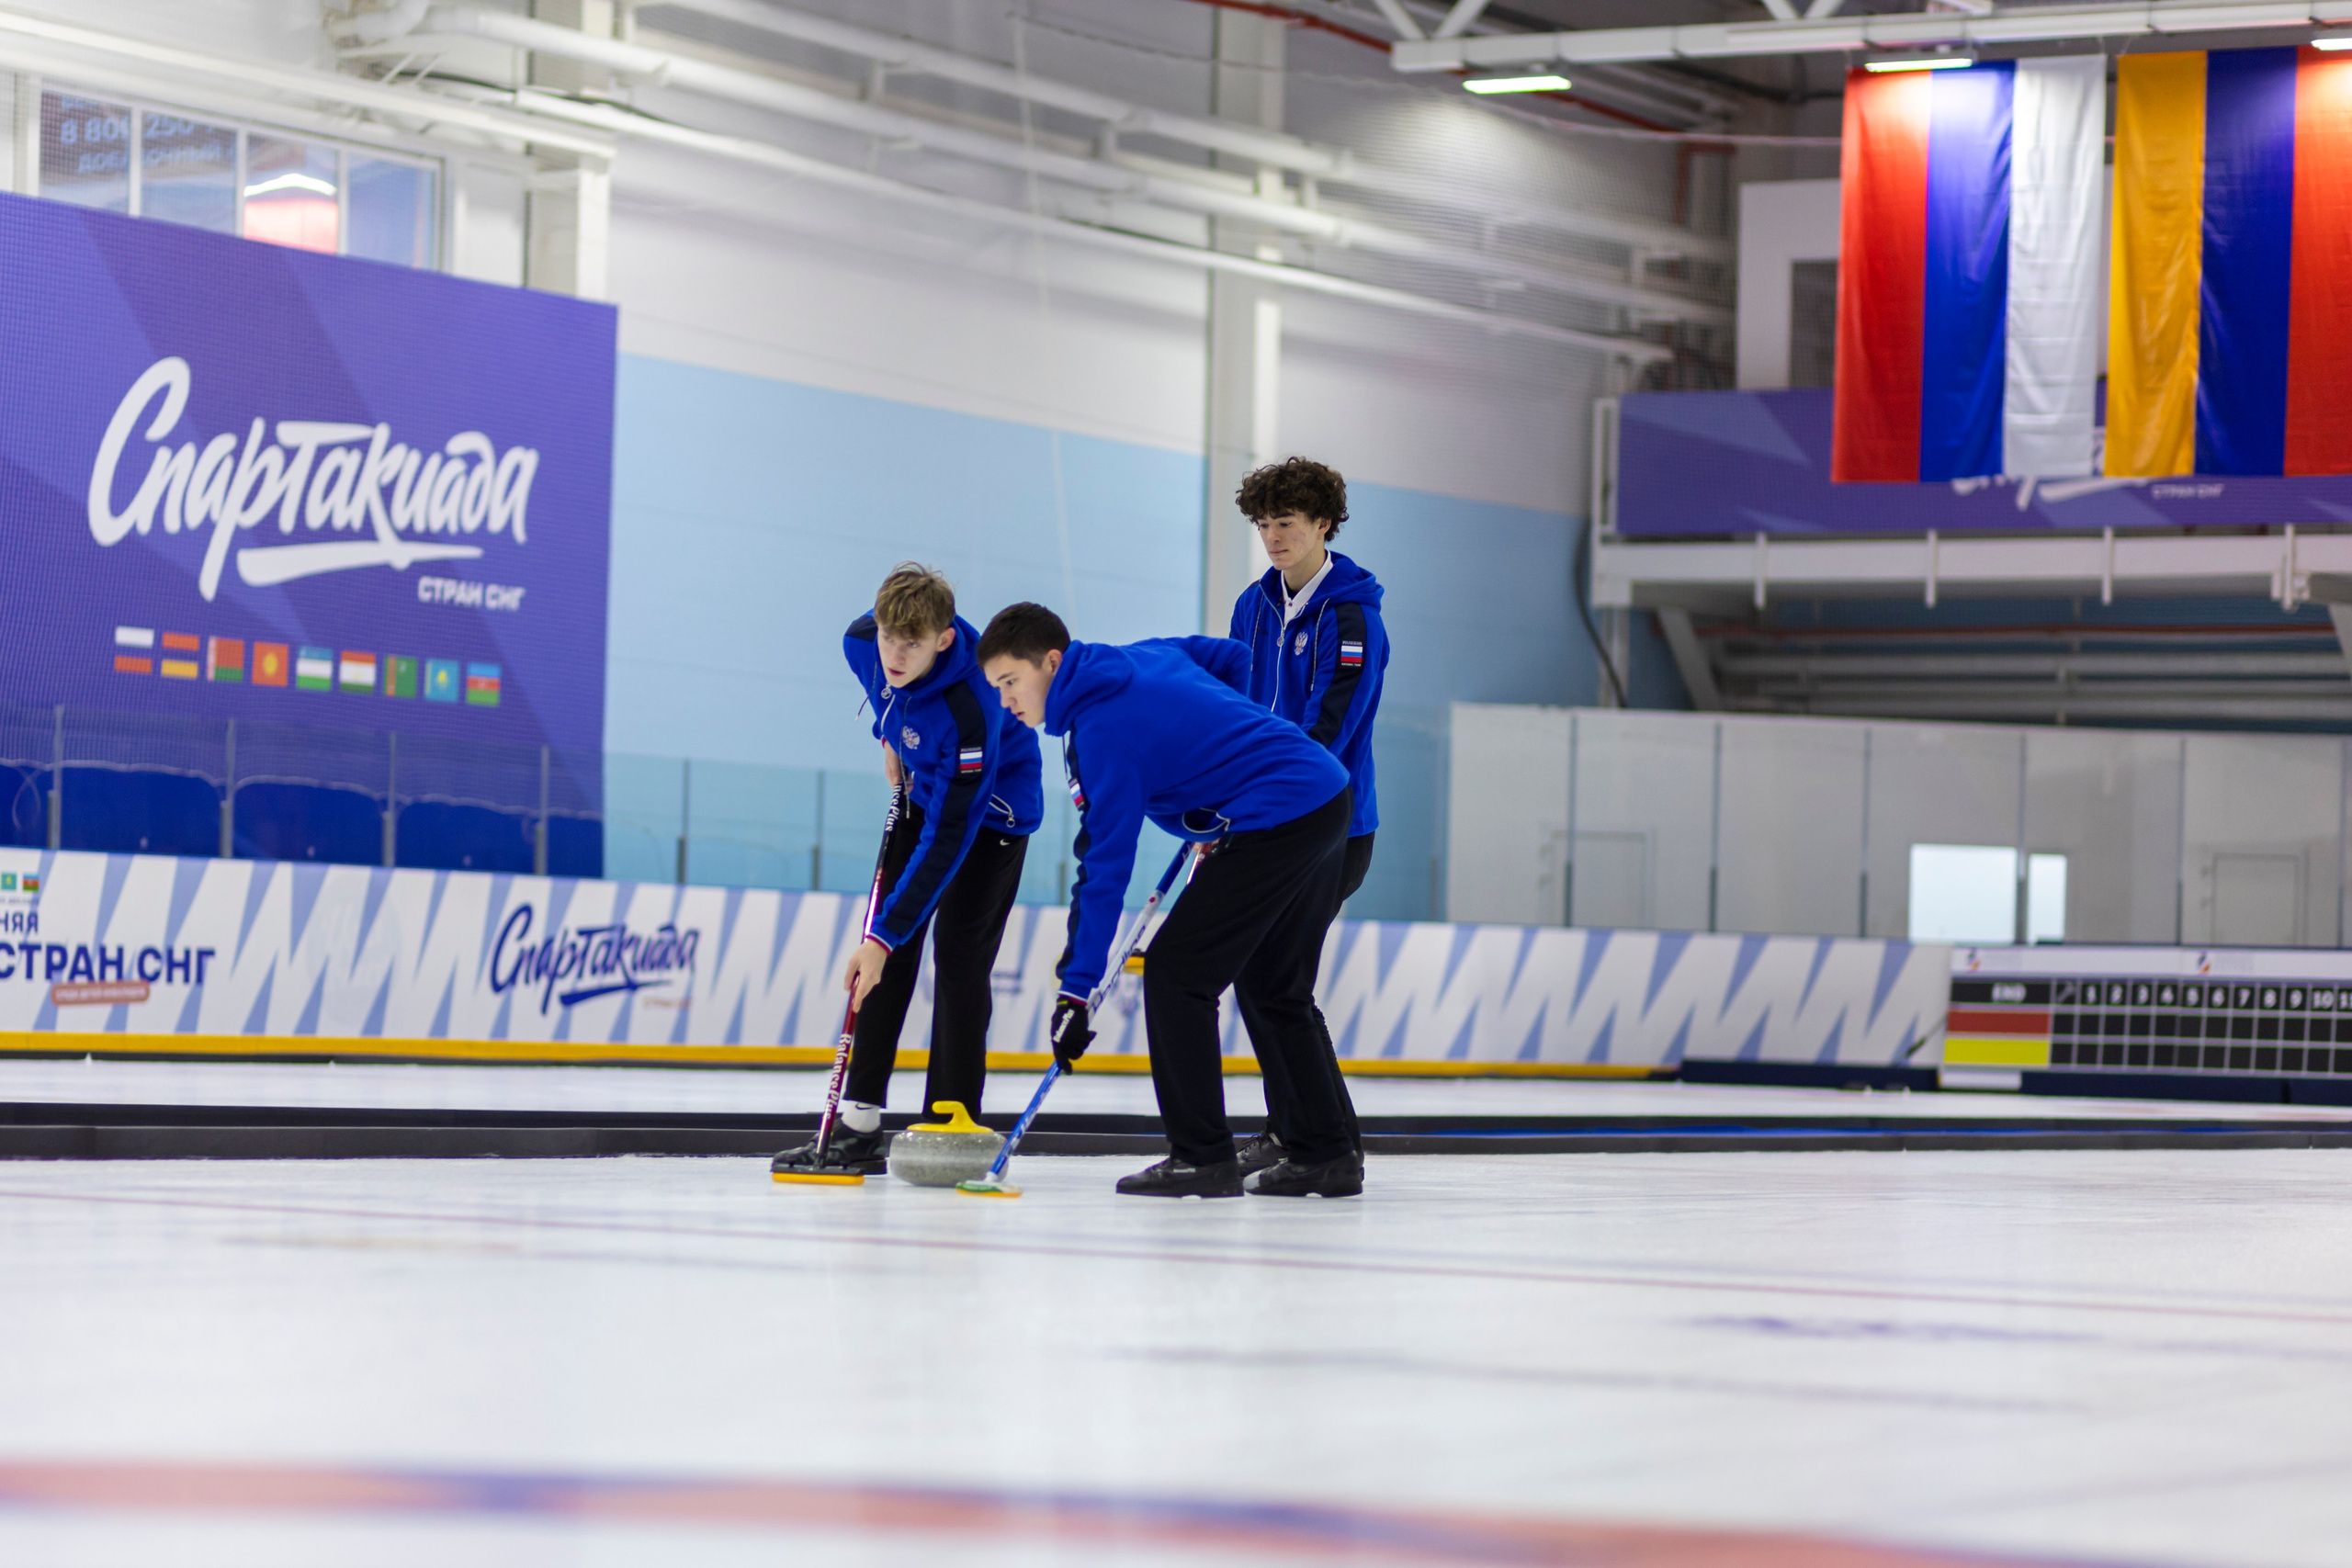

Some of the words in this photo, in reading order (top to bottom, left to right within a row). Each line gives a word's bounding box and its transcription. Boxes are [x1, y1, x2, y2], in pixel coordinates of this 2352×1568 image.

[88, 355, 539, 602] Спартакиада
[418, 575, 484, 608] СТРАН
[484, 583, 526, 613] СНГ
[885, 784, 902, 831] ncePlus
[0, 941, 125, 983] СТРАН
[137, 946, 216, 985] СНГ
[491, 903, 700, 1016] Спартакиада
[2086, 985, 2097, 1004] 1
[2111, 984, 2123, 1004] 2
[2137, 985, 2149, 1004] 3
[2161, 986, 2174, 1005] 4
[2187, 987, 2199, 1006] 5
[2211, 987, 2224, 1007] 6
[2238, 988, 2250, 1008] 7
[2264, 989, 2277, 1009] 8
[2290, 989, 2302, 1009] 9
[2312, 989, 2335, 1009] 10
[825, 1033, 853, 1120] BalancePlus
